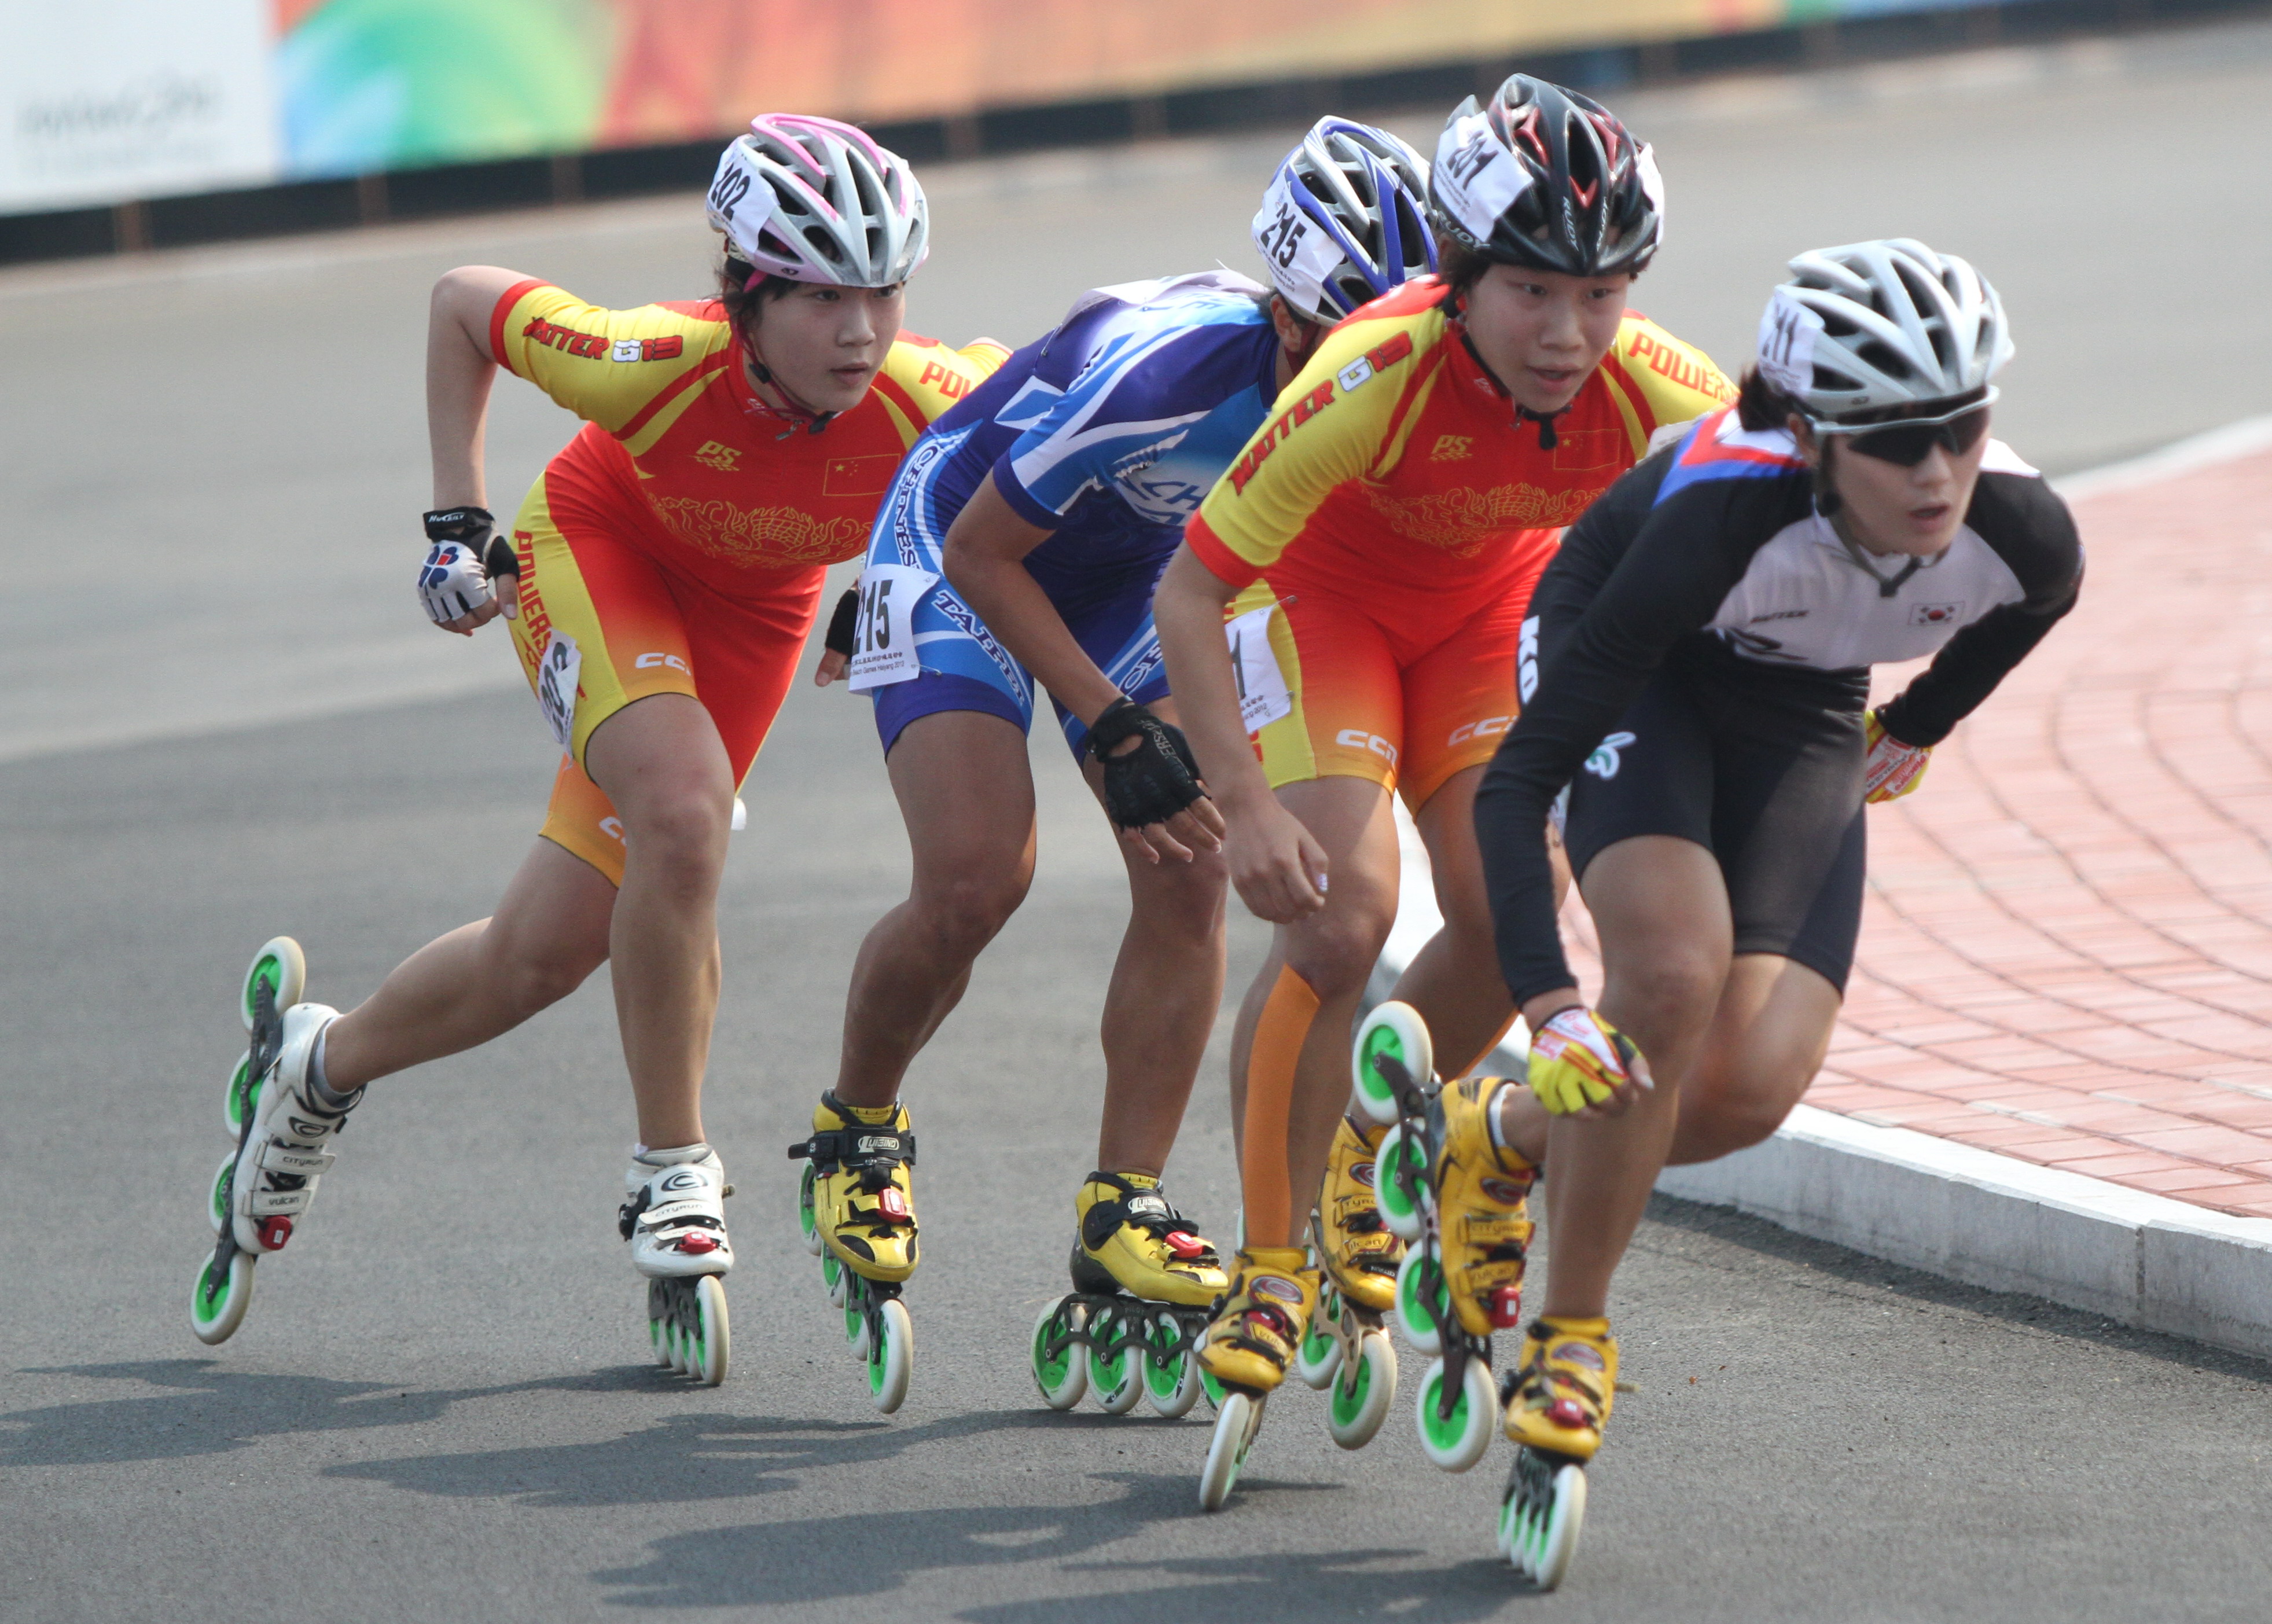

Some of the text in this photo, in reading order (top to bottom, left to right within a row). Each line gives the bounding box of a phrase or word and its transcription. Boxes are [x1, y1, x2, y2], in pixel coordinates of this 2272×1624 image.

[711, 162, 750, 221] 202
[1446, 130, 1499, 191] 201
[1260, 203, 1307, 268] 215
[696, 440, 742, 465] PS
[1227, 379, 1335, 497] MATTER
[1432, 435, 1473, 455] PS
[894, 443, 942, 571] CHINES
[852, 579, 893, 655] 215
[932, 589, 1024, 707] TAIPEI
